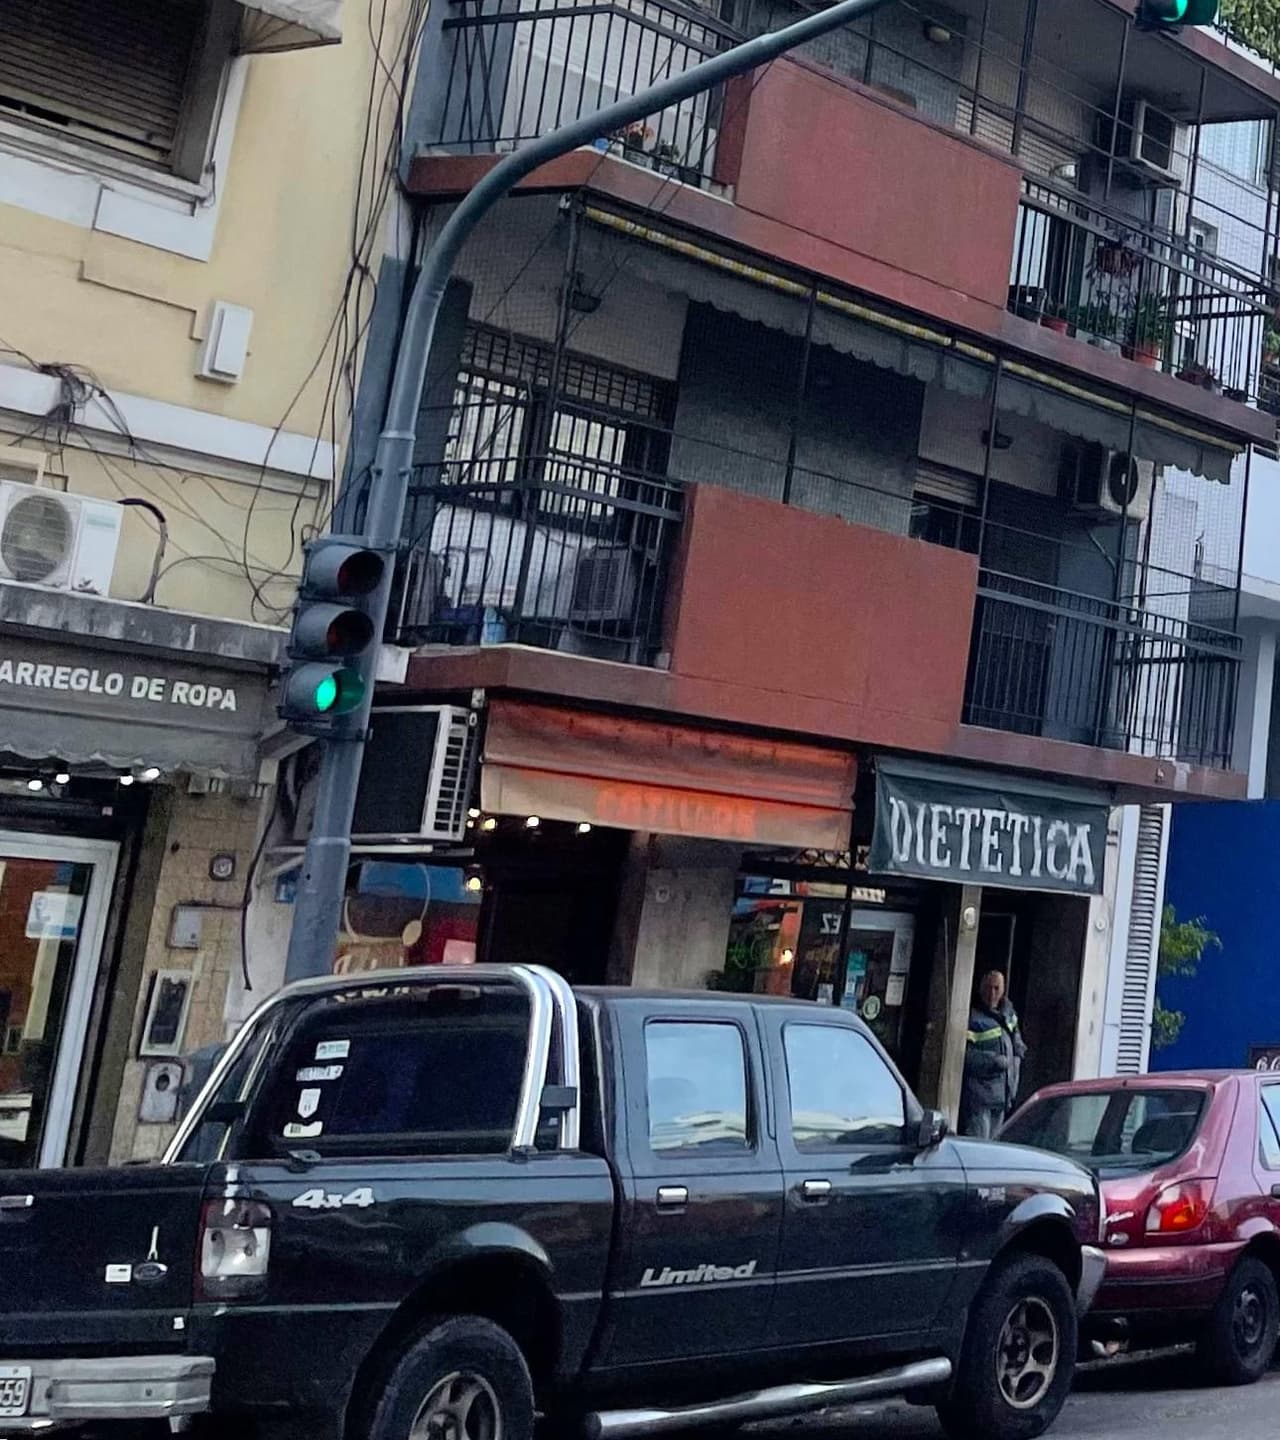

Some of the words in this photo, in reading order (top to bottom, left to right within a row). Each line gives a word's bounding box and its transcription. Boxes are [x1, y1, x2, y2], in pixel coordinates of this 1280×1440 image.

[0, 661, 124, 695] ARREGLO
[131, 676, 166, 701] DE
[171, 681, 237, 710] ROPA
[890, 796, 1095, 885] DIETETICA
[292, 1187, 375, 1208] 4x4
[640, 1260, 758, 1287] Limited
